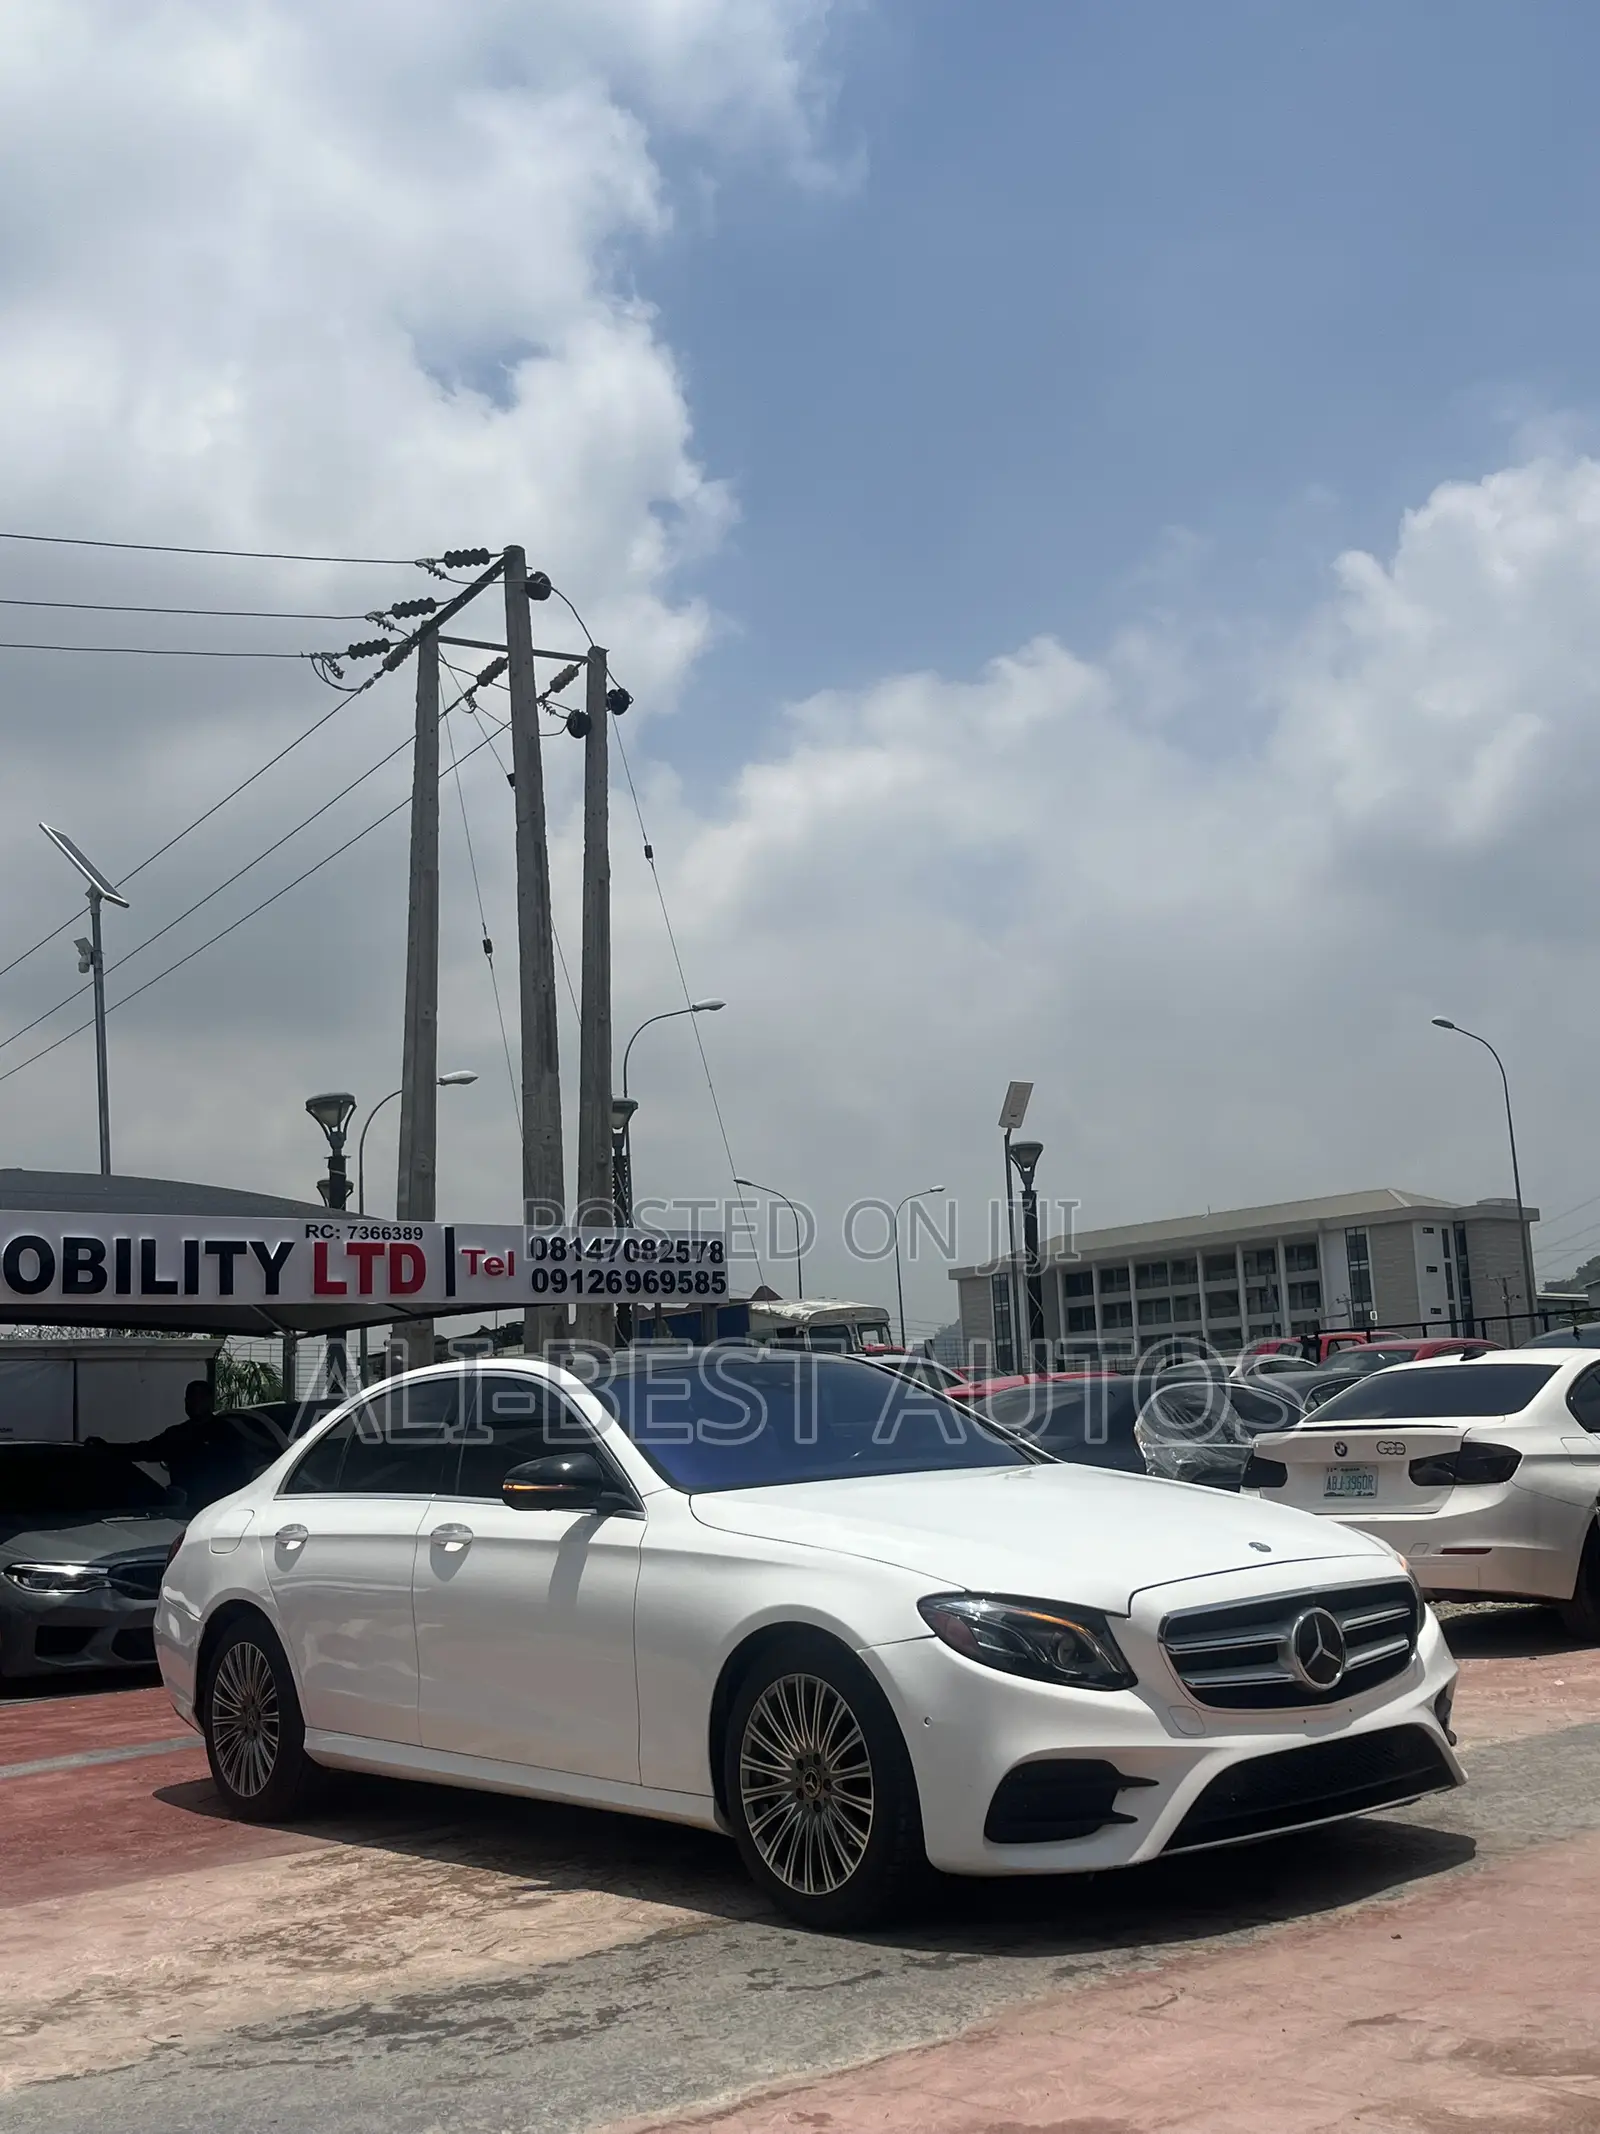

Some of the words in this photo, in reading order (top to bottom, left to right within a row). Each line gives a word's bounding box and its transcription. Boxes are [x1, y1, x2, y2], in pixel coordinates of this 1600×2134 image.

[304, 1224, 341, 1240] RC:
[347, 1226, 424, 1241] 7366389
[461, 1248, 515, 1277] Tel
[530, 1236, 724, 1264] 08147082578
[2, 1234, 296, 1296] OBILITY
[313, 1241, 427, 1295] LTD
[531, 1267, 727, 1295] 09126969585
